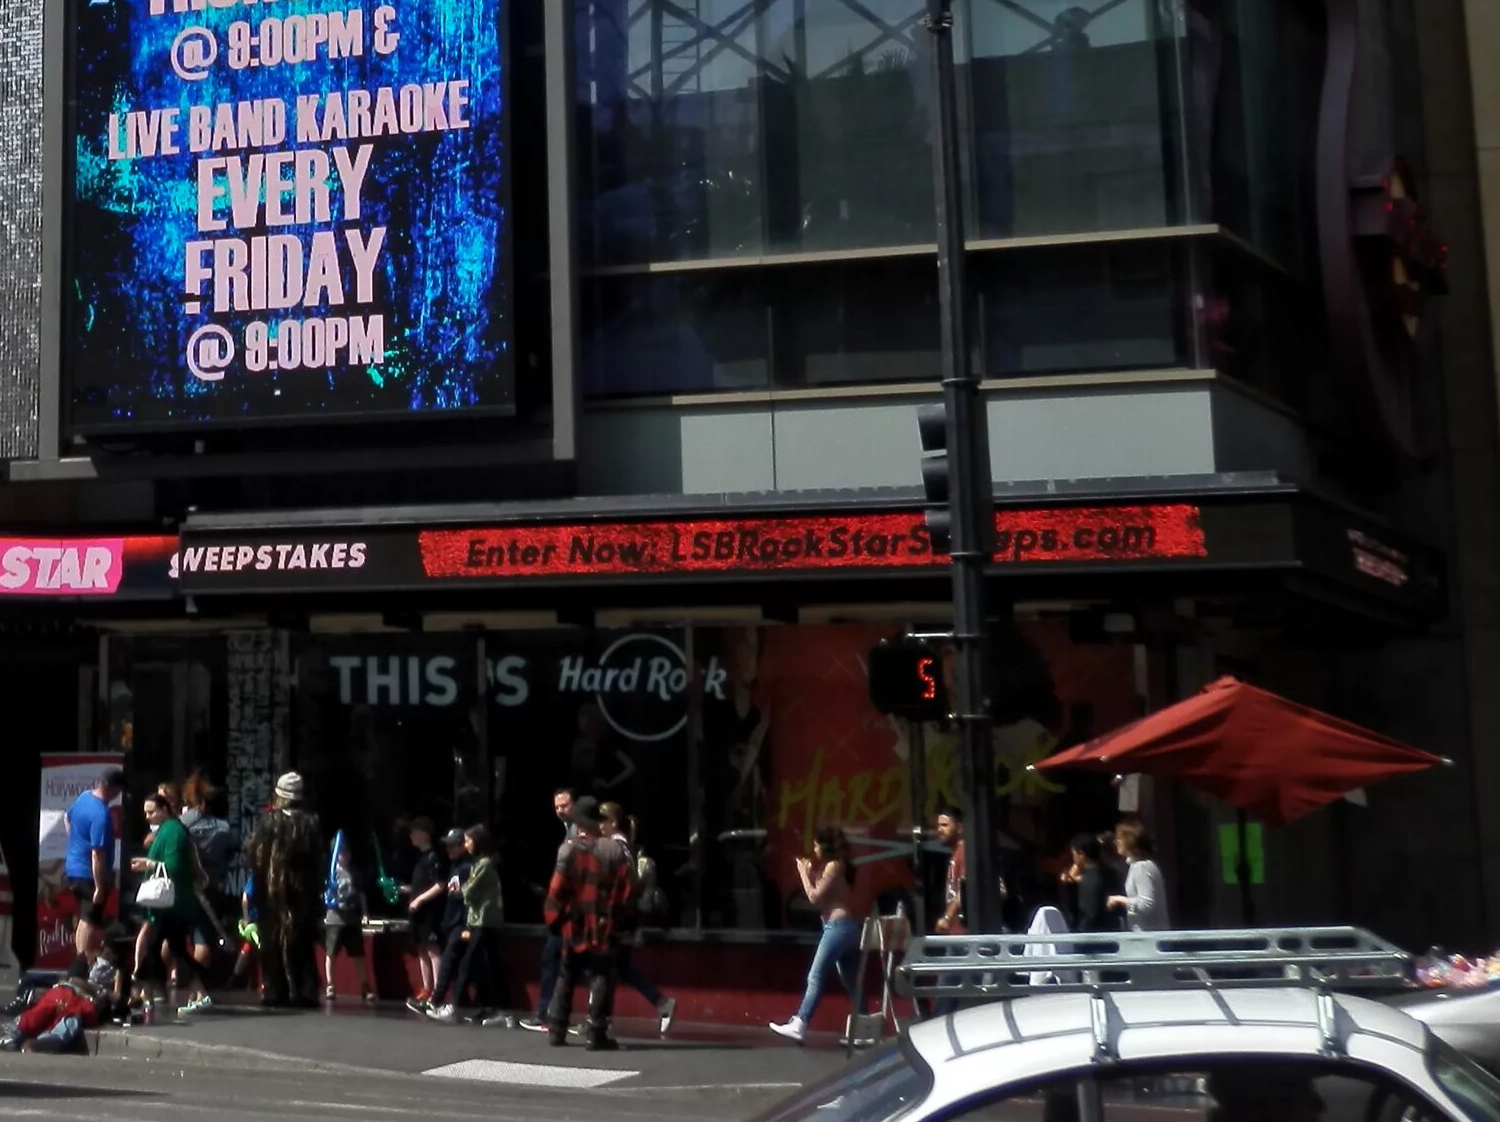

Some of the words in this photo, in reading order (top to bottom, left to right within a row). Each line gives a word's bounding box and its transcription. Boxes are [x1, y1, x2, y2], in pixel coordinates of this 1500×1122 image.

[170, 26, 218, 81] @
[228, 9, 363, 70] 9:00PM
[108, 108, 180, 160] LIVE
[188, 98, 286, 153] BAND
[297, 79, 470, 143] KARAOKE
[197, 144, 374, 232] EVERY
[185, 226, 386, 315] FRIDAY
[186, 324, 234, 381] @
[245, 315, 384, 372] 9:00PM
[0, 547, 112, 589] STAR
[467, 539, 556, 567] Enter
[330, 656, 458, 706] THIS
[557, 655, 644, 693] Hard
[646, 655, 728, 702] Rok
[916, 656, 936, 700] 5
